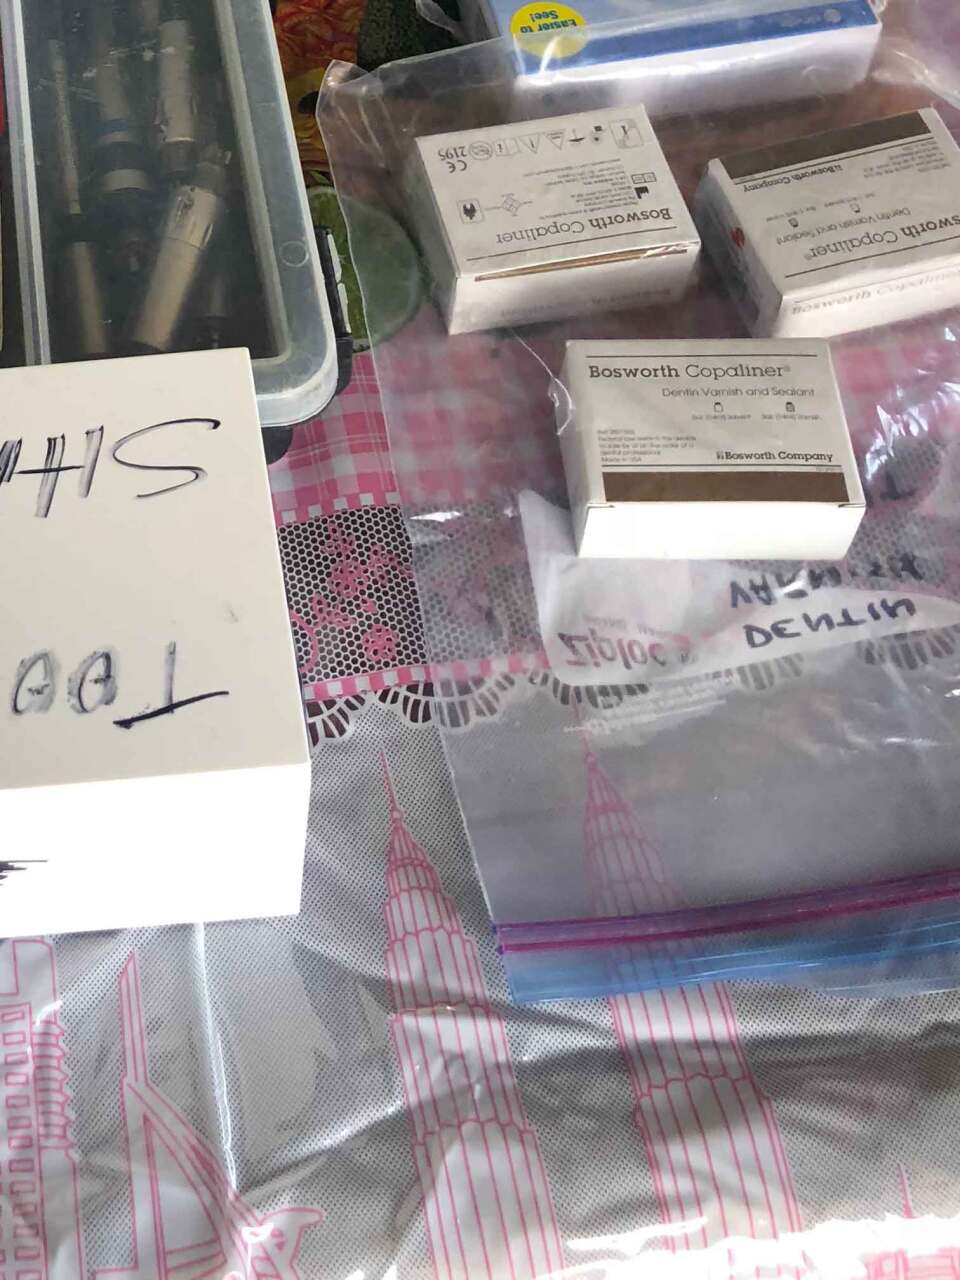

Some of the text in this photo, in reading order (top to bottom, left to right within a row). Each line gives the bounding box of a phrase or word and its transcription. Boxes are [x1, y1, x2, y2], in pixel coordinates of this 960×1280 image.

[437, 143, 468, 161] 2195
[495, 207, 673, 245] Bosworth Copaliner
[900, 214, 960, 238] sworth
[588, 365, 681, 379] Bosworth
[661, 386, 815, 398] Dentin Varnish and Sealant
[724, 451, 834, 462] Bosworth Company
